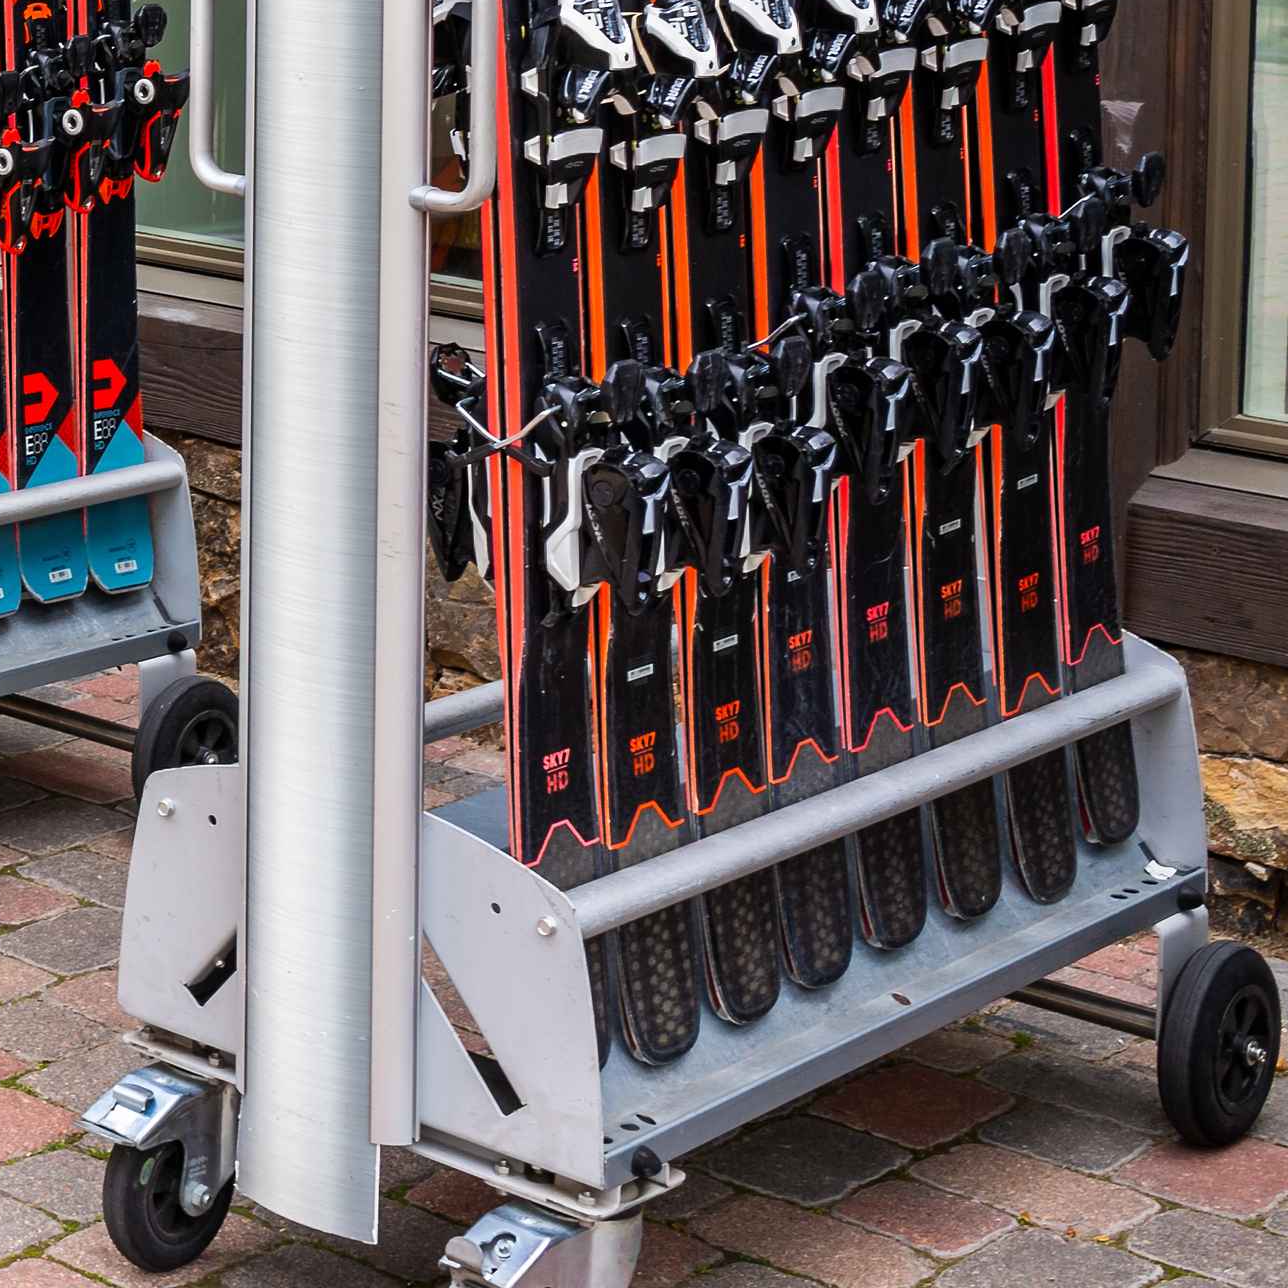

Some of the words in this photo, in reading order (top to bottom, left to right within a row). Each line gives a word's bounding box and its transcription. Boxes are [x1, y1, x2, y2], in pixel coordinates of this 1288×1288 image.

[1080, 526, 1101, 545] SKY7
[1083, 544, 1101, 564] HD
[940, 579, 963, 599] SKY7
[1018, 572, 1040, 592] SKY7
[866, 601, 890, 622] SKY7
[944, 598, 962, 618] HD
[1021, 592, 1039, 612] HD
[788, 629, 813, 650] SKY7
[869, 621, 889, 641] HD
[790, 650, 813, 673] HD
[714, 699, 741, 721] SKY7
[629, 730, 657, 753] SKY7
[719, 721, 740, 744] HD
[542, 747, 571, 771] SKY7
[633, 753, 656, 777] HD
[546, 772, 569, 795] HD
